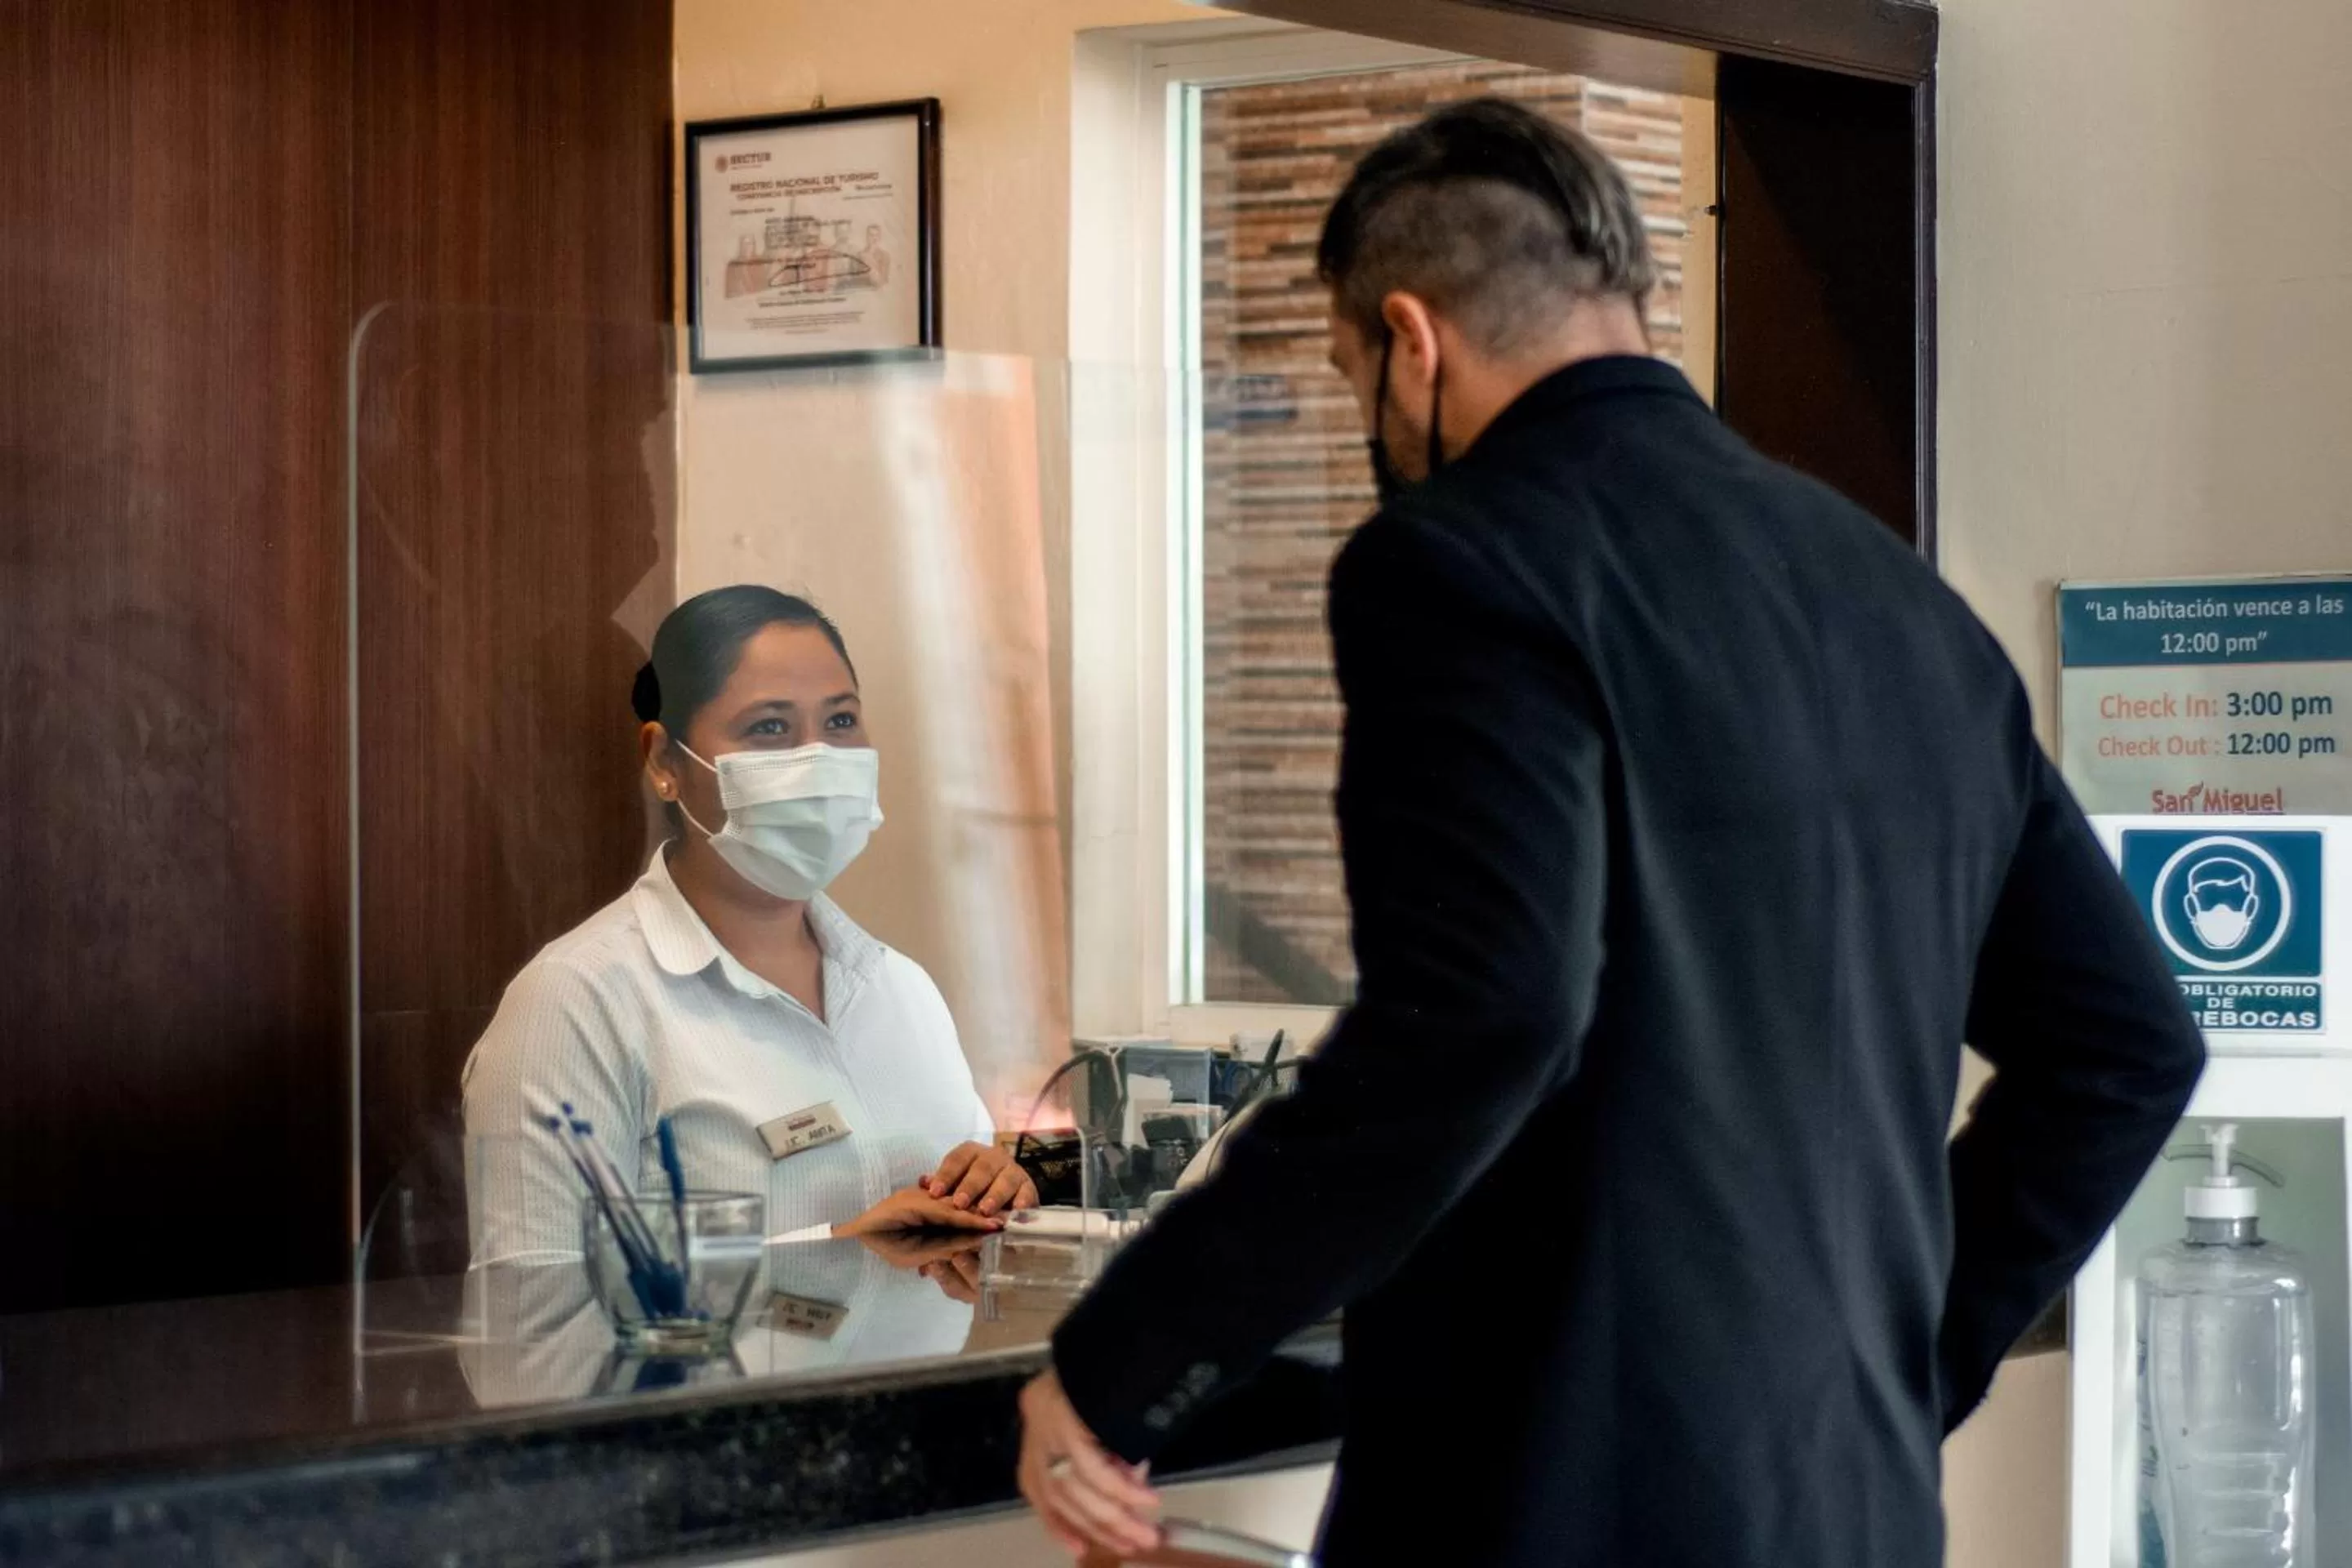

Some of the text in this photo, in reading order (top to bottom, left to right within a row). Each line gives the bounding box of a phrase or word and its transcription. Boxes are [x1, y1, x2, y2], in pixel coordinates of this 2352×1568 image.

[776, 176, 819, 189] NACIONAL
[822, 175, 834, 185] DE
[839, 172, 879, 183] TURISMO
[2123, 599, 2227, 620] habitación
[2234, 599, 2292, 617] vence
[2299, 600, 2309, 614] a
[2316, 595, 2344, 614] las
[2162, 633, 2219, 653] 12:00
[2100, 692, 2332, 720] Check In: 3:00 pm
[2098, 736, 2160, 756] Check
[2227, 733, 2290, 755] 12:00
[2298, 737, 2335, 758] pm
[2152, 788, 2283, 814] San Miguel
[2207, 996, 2234, 1009] DE
